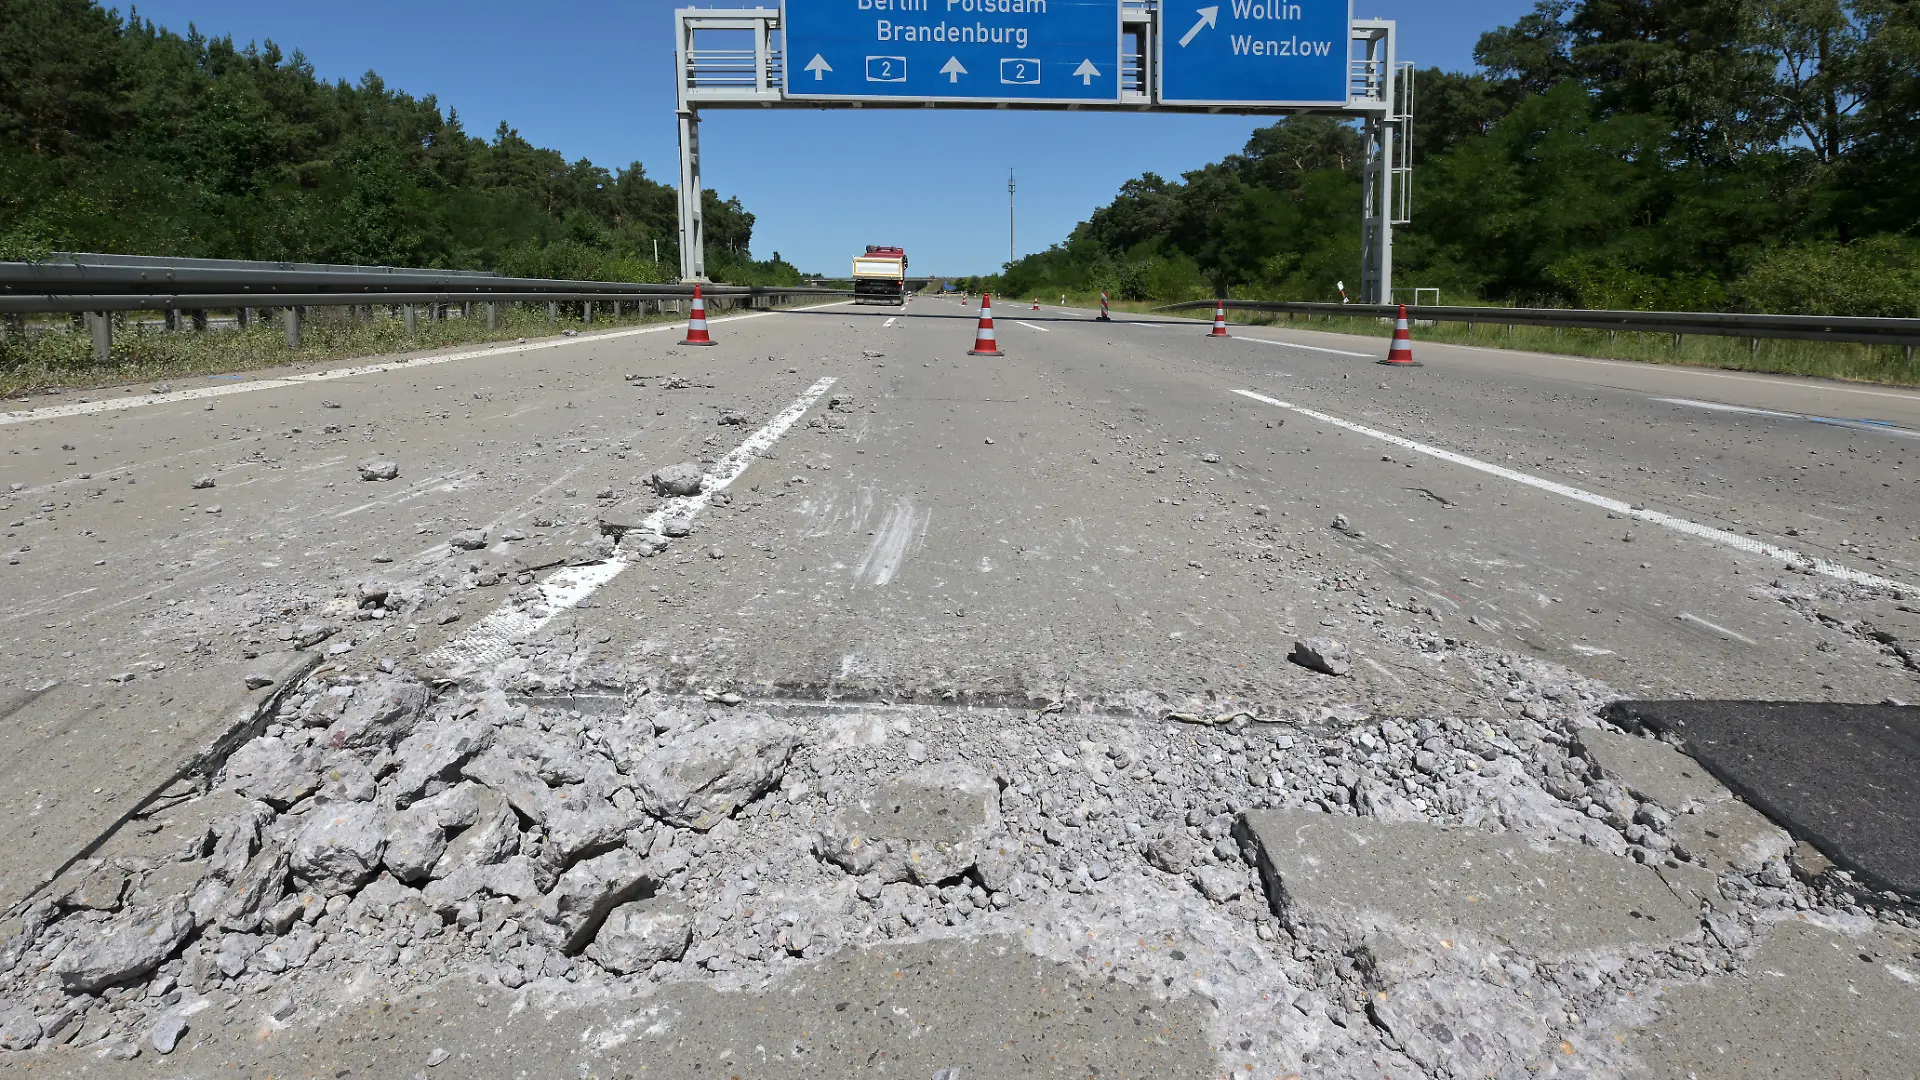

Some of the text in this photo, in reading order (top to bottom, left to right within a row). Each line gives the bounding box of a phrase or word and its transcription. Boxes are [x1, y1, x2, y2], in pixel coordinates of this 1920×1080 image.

[947, 0, 1047, 13] Potsdam
[1231, 0, 1301, 20] Wollin
[877, 19, 1028, 49] Brandenburg
[1230, 35, 1332, 57] Wenzlow
[882, 62, 891, 77] 2
[1016, 63, 1025, 78] 2
